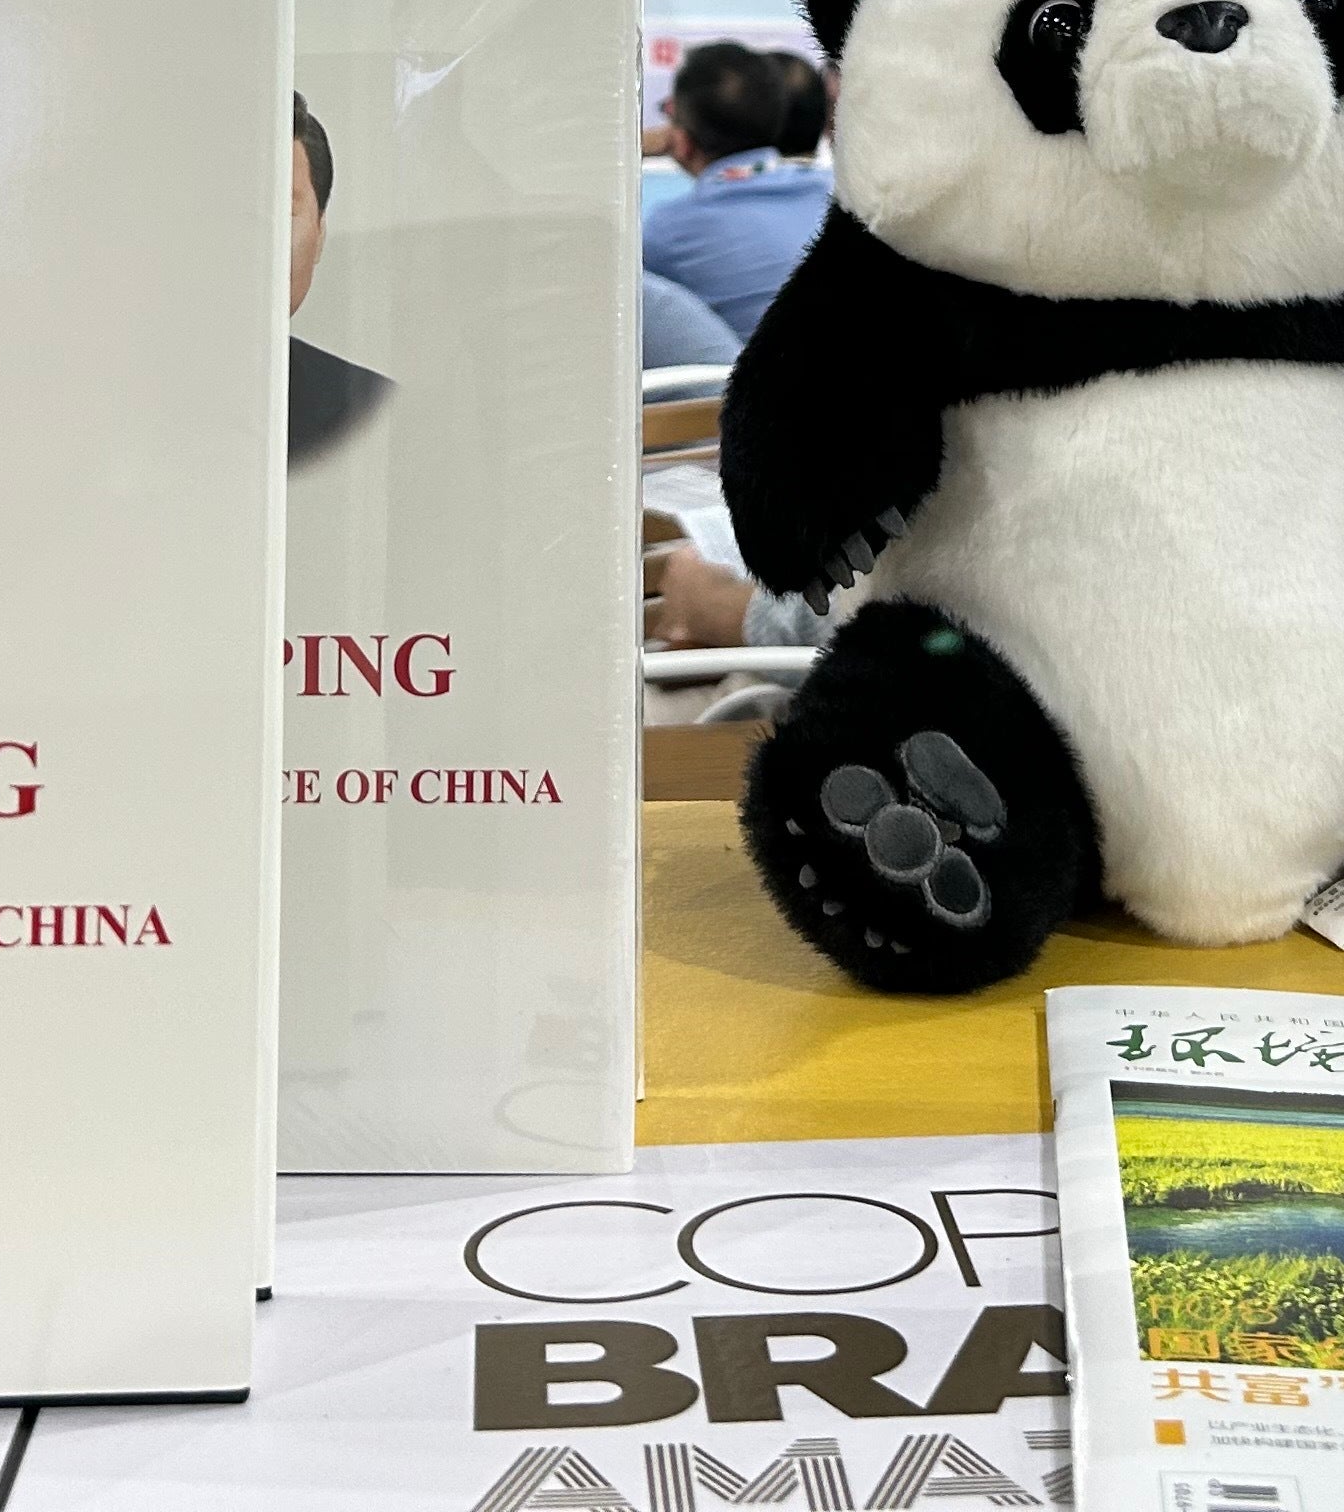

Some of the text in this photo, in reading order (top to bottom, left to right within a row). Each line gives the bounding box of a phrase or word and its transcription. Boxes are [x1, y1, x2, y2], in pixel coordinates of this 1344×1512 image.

[283, 633, 456, 698] ING
[336, 768, 399, 804] OF
[410, 768, 563, 804] CHINA
